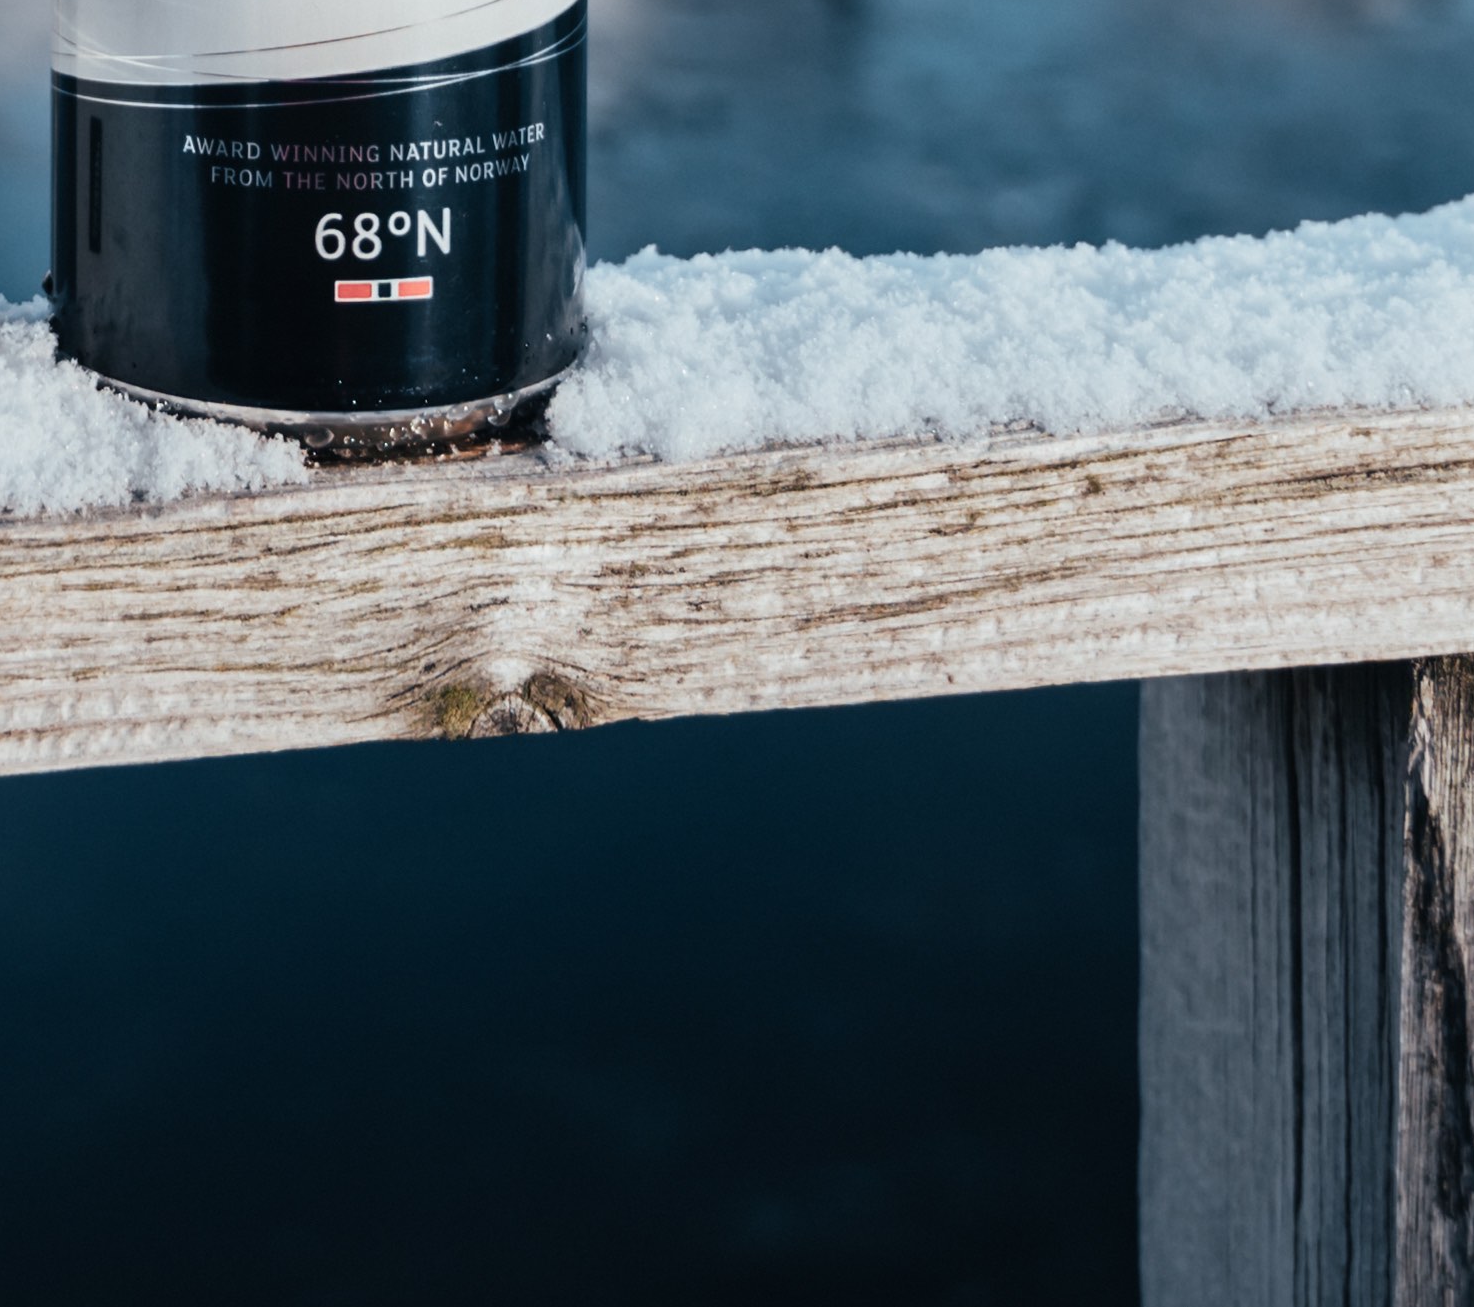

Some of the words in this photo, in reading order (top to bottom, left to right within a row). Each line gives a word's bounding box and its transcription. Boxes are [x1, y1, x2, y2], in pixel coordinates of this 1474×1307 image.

[183, 135, 261, 160] AWARD
[270, 144, 380, 163] WINNING
[390, 136, 485, 162] NATURAL
[492, 122, 545, 150] WATER
[211, 166, 273, 188] FROM
[283, 172, 326, 190] THE
[336, 170, 414, 190] NORTH
[422, 167, 449, 188] OF
[454, 153, 530, 184] NORWAY
[314, 207, 451, 260] 68°N
